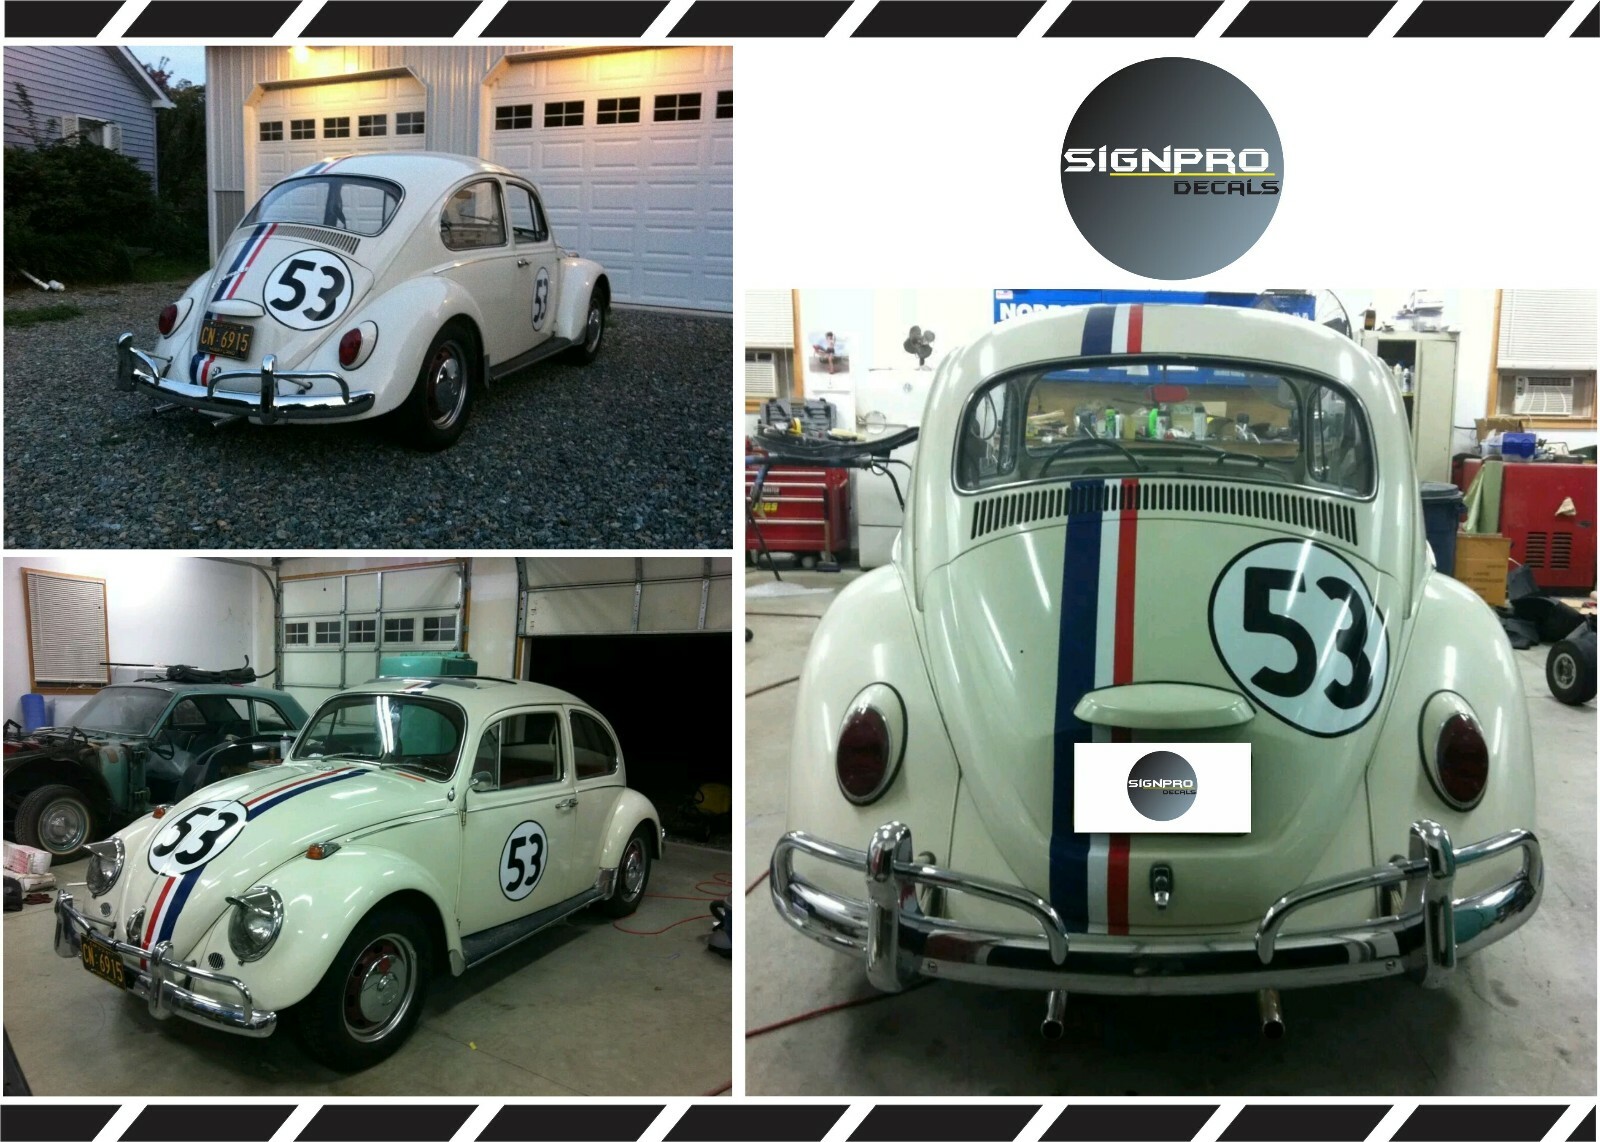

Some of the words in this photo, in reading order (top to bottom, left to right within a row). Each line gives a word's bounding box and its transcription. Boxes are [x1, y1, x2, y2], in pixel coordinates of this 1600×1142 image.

[269, 258, 346, 322] 53
[533, 278, 549, 323] 53
[1243, 566, 1374, 710] 53
[152, 806, 239, 866] 53
[505, 832, 544, 893] 53
